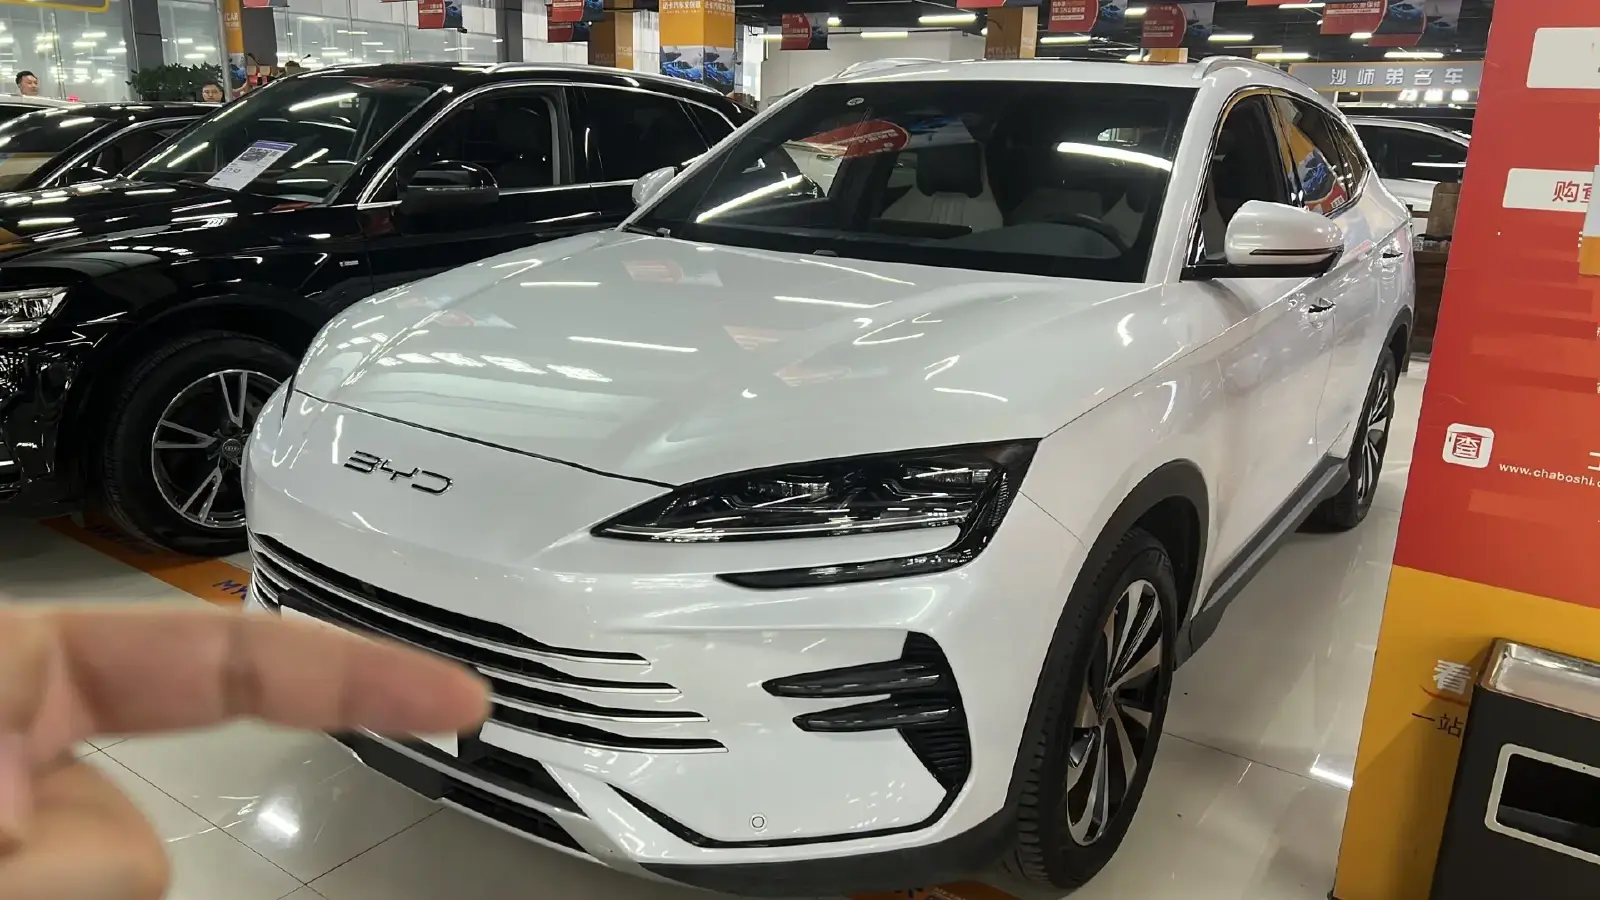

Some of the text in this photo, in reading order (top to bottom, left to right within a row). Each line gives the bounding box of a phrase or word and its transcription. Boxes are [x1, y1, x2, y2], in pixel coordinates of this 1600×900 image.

[1329, 67, 1465, 86] 沙师弟名车
[343, 450, 453, 495] BYD
[1433, 659, 1472, 696] 看
[1411, 712, 1465, 738] 一站
